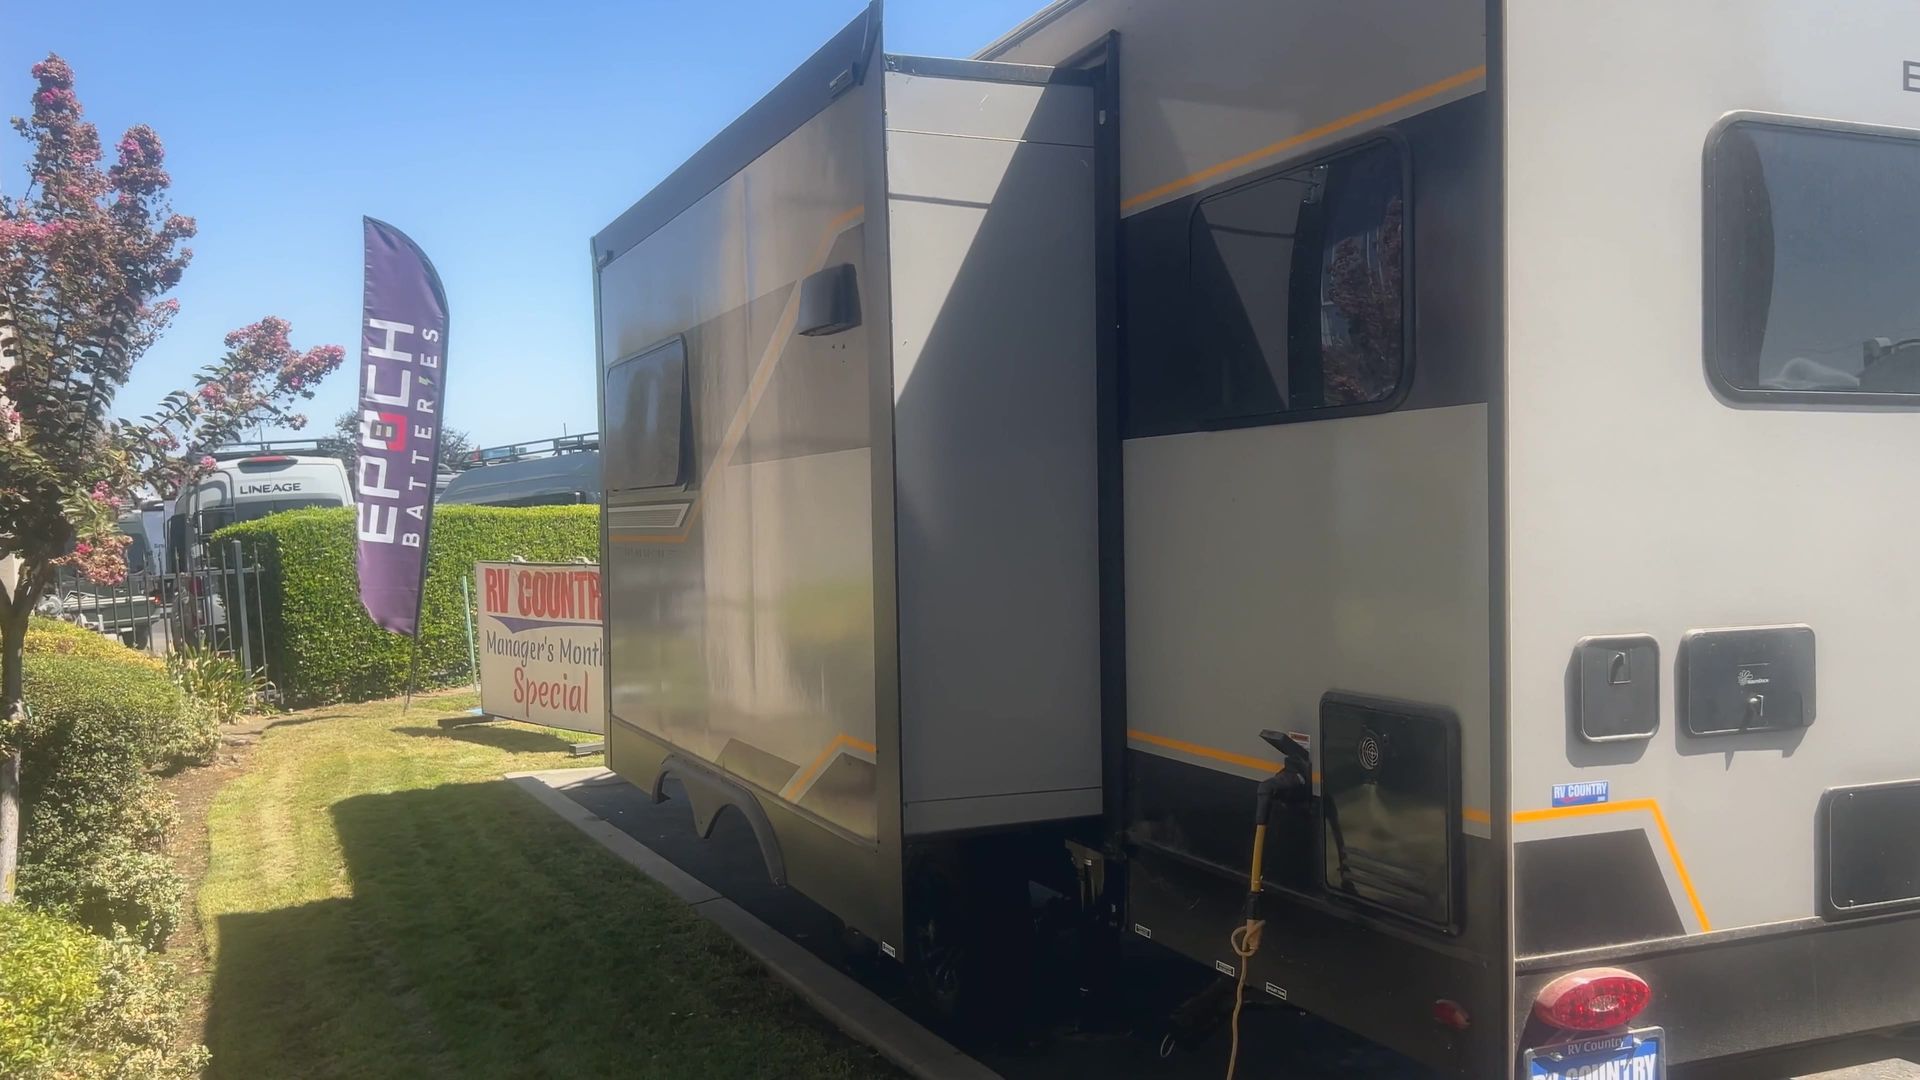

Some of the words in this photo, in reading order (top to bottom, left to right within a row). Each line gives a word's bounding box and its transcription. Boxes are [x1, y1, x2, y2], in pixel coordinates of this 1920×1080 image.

[357, 318, 415, 544] EPOCH
[240, 482, 302, 495] LINEAGE
[485, 567, 510, 614] RV
[486, 629, 554, 668] Manager's
[513, 666, 589, 718] Special
[1554, 785, 1566, 799] RV
[1567, 782, 1607, 798] COUNTRY
[1567, 1043, 1581, 1056] RV
